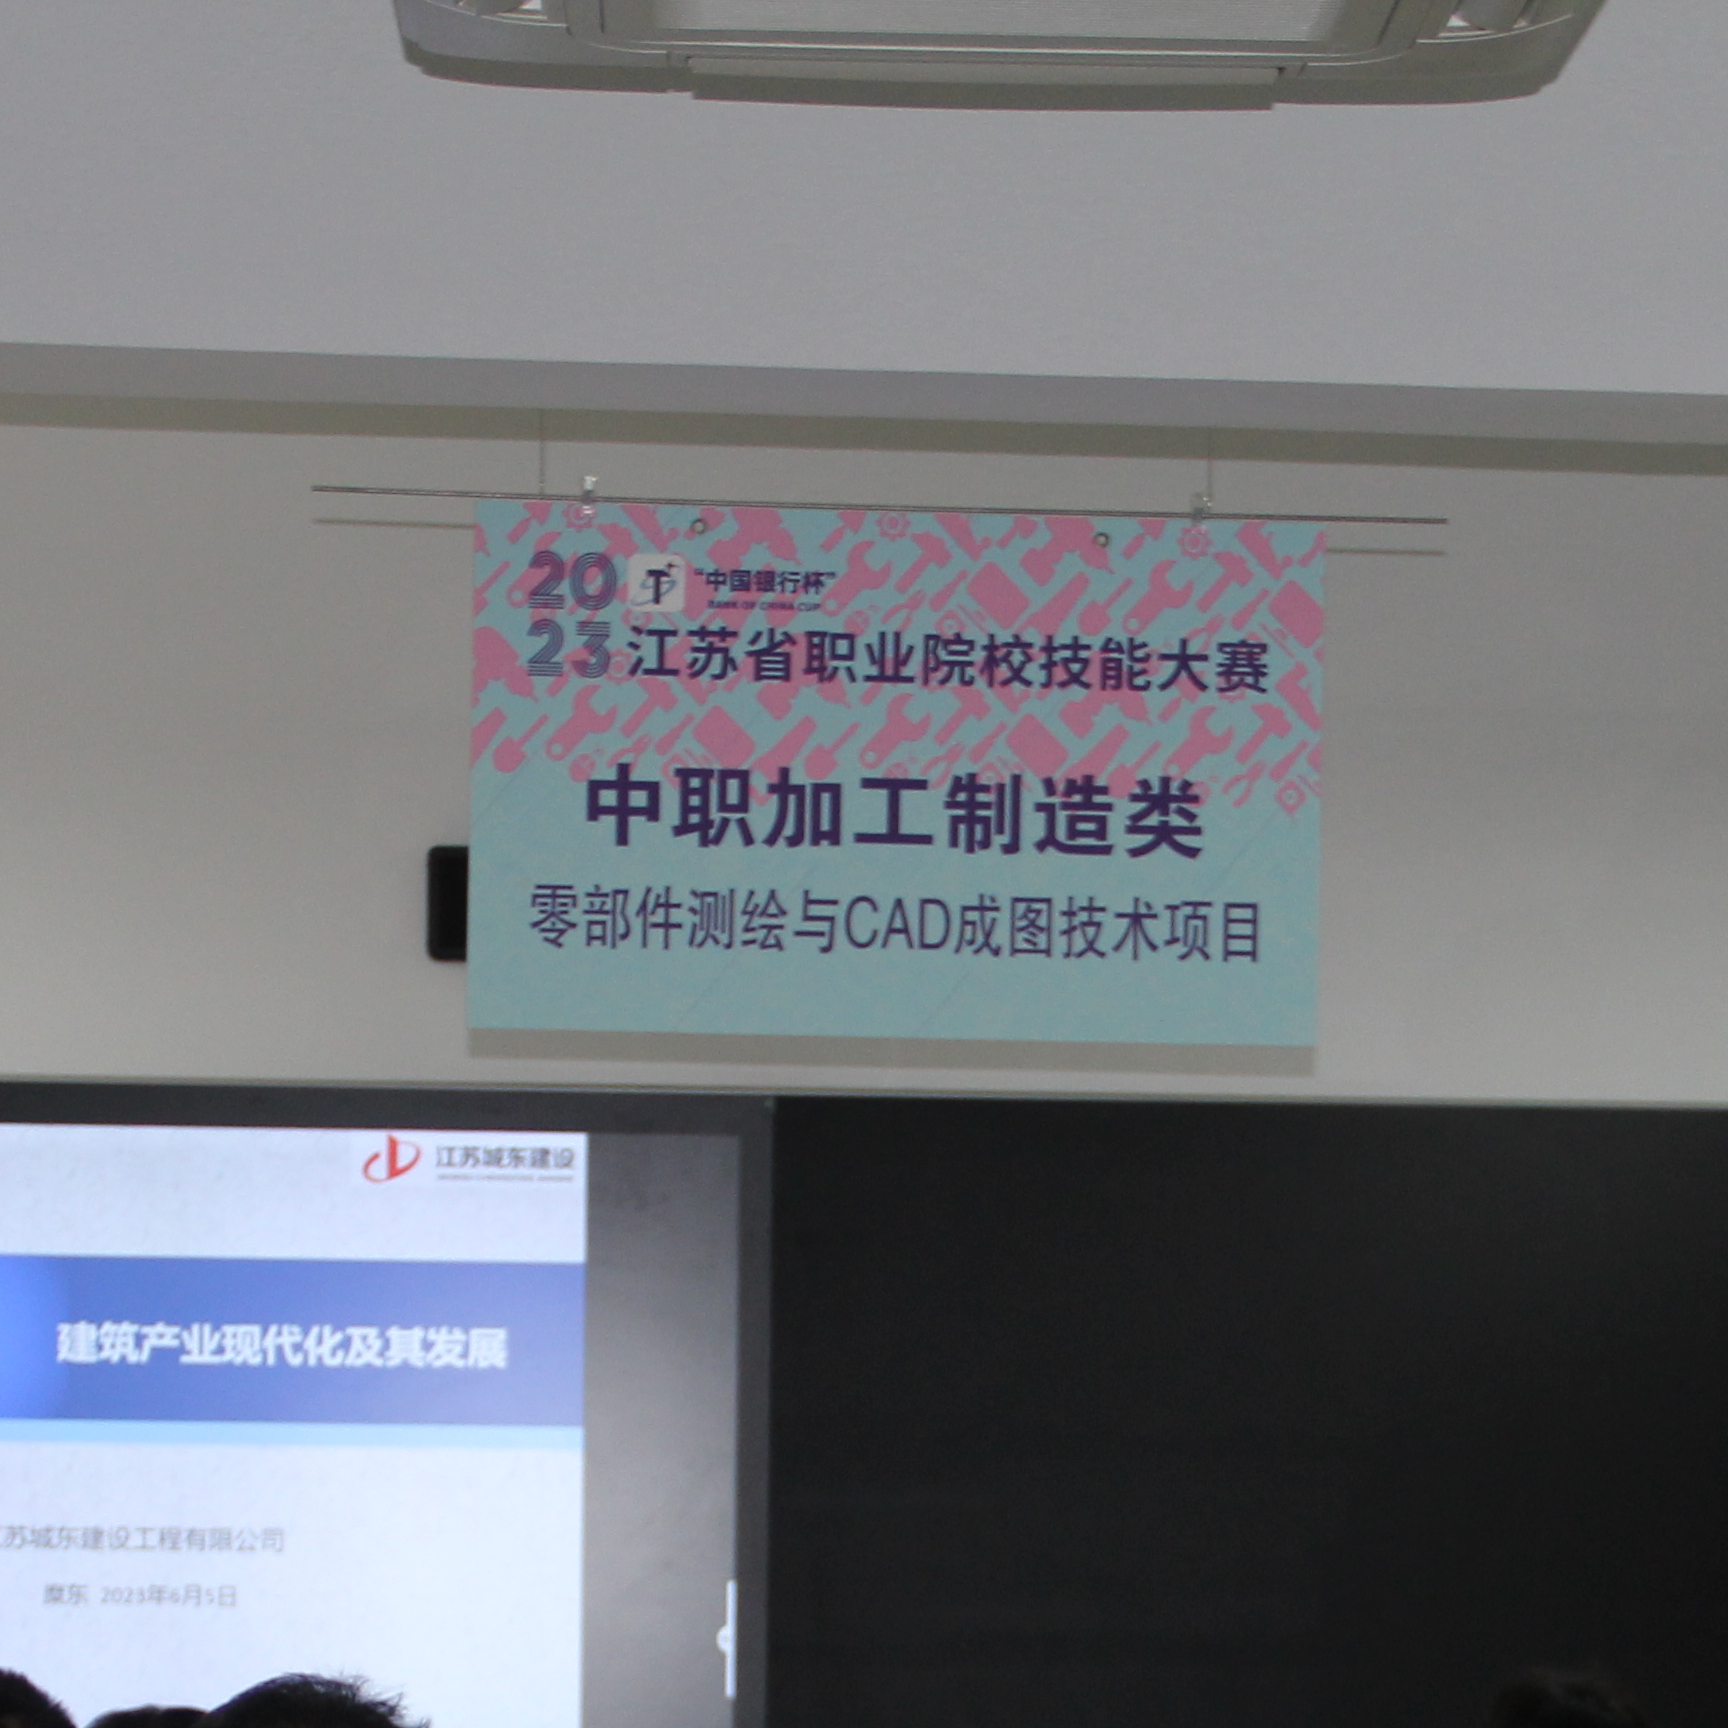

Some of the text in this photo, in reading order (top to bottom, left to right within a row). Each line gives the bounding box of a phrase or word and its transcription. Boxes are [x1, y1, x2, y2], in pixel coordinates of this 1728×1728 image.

[527, 549, 619, 611] 20
[526, 618, 611, 679] 23
[626, 623, 1271, 695] 江苏省职业院校技能大赛
[584, 763, 1205, 859] 中职加工制造类
[527, 880, 1263, 965] 零部件测绘与CAD成图技术项目
[436, 1145, 575, 1169] 江苏城东建设
[55, 1321, 509, 1371] 建筑产业现代化及其发展
